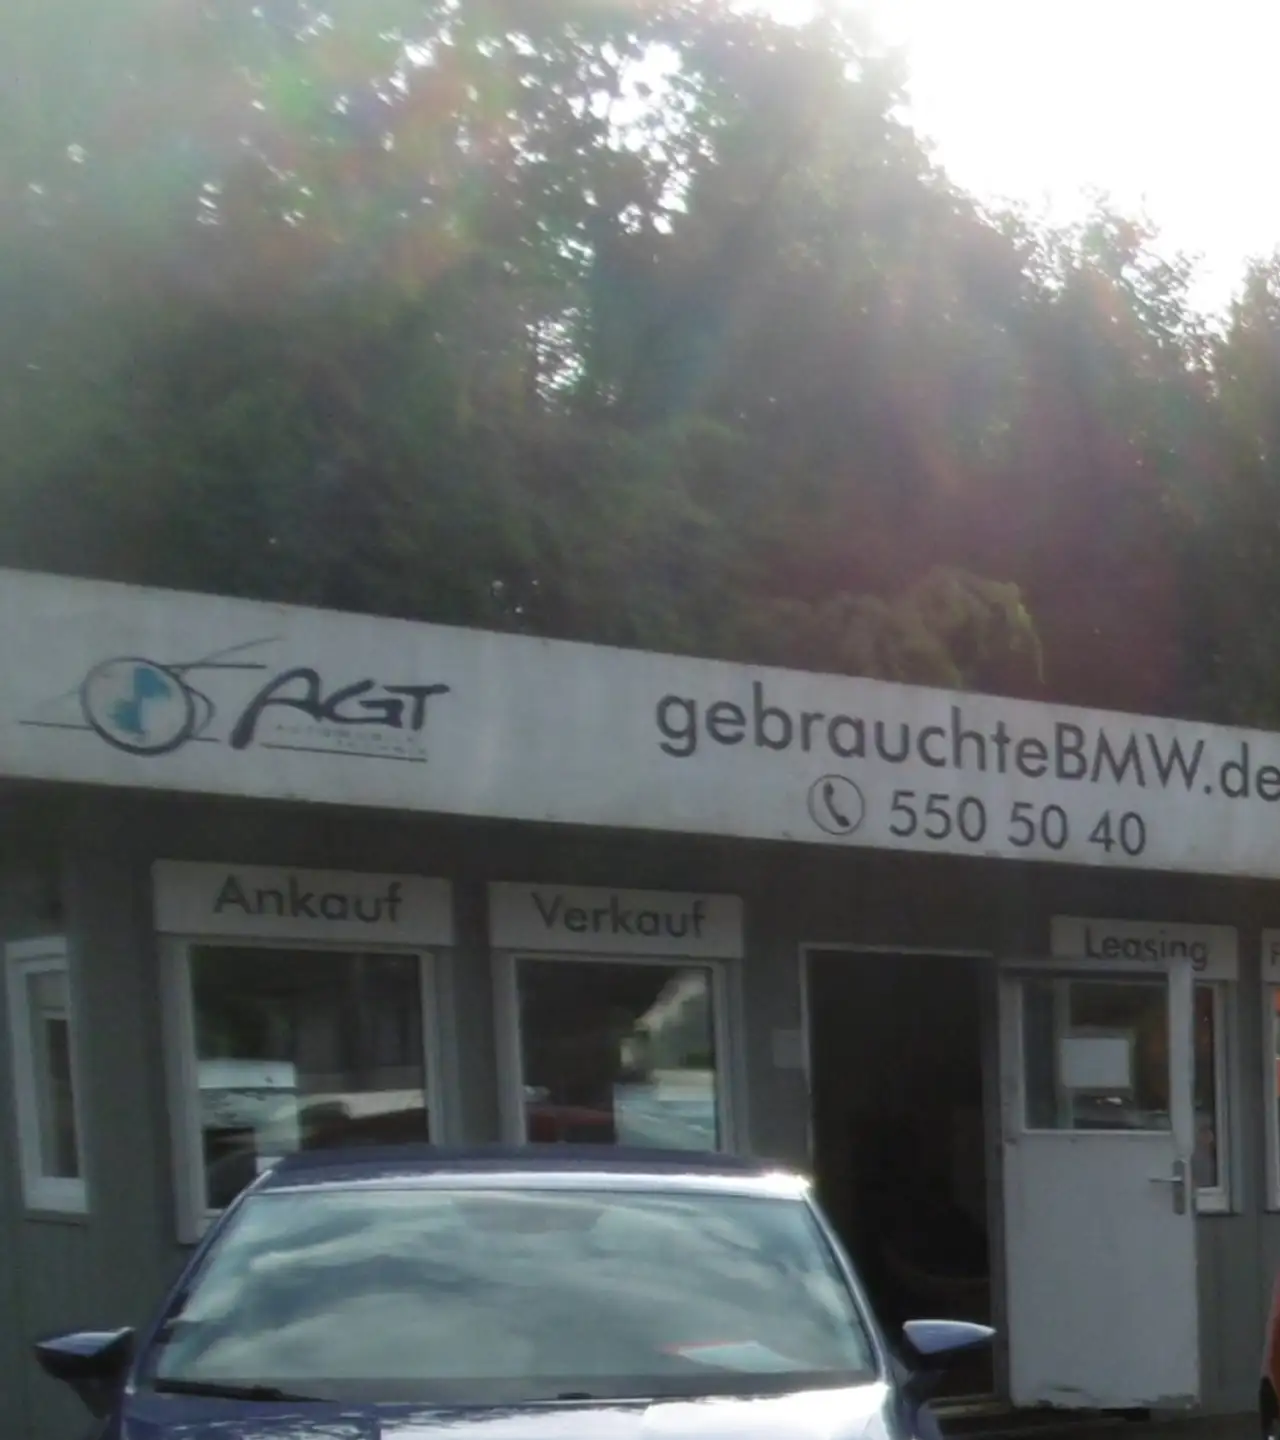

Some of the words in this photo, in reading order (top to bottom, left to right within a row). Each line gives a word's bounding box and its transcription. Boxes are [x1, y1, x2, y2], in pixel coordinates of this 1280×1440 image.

[228, 667, 450, 750] AGT
[888, 790, 986, 843] 550
[1007, 801, 1069, 851] 50
[1087, 810, 1147, 857] 40
[213, 874, 404, 923] Ankauf
[530, 890, 707, 939] Verkauf
[1084, 925, 1210, 972] Leasing
